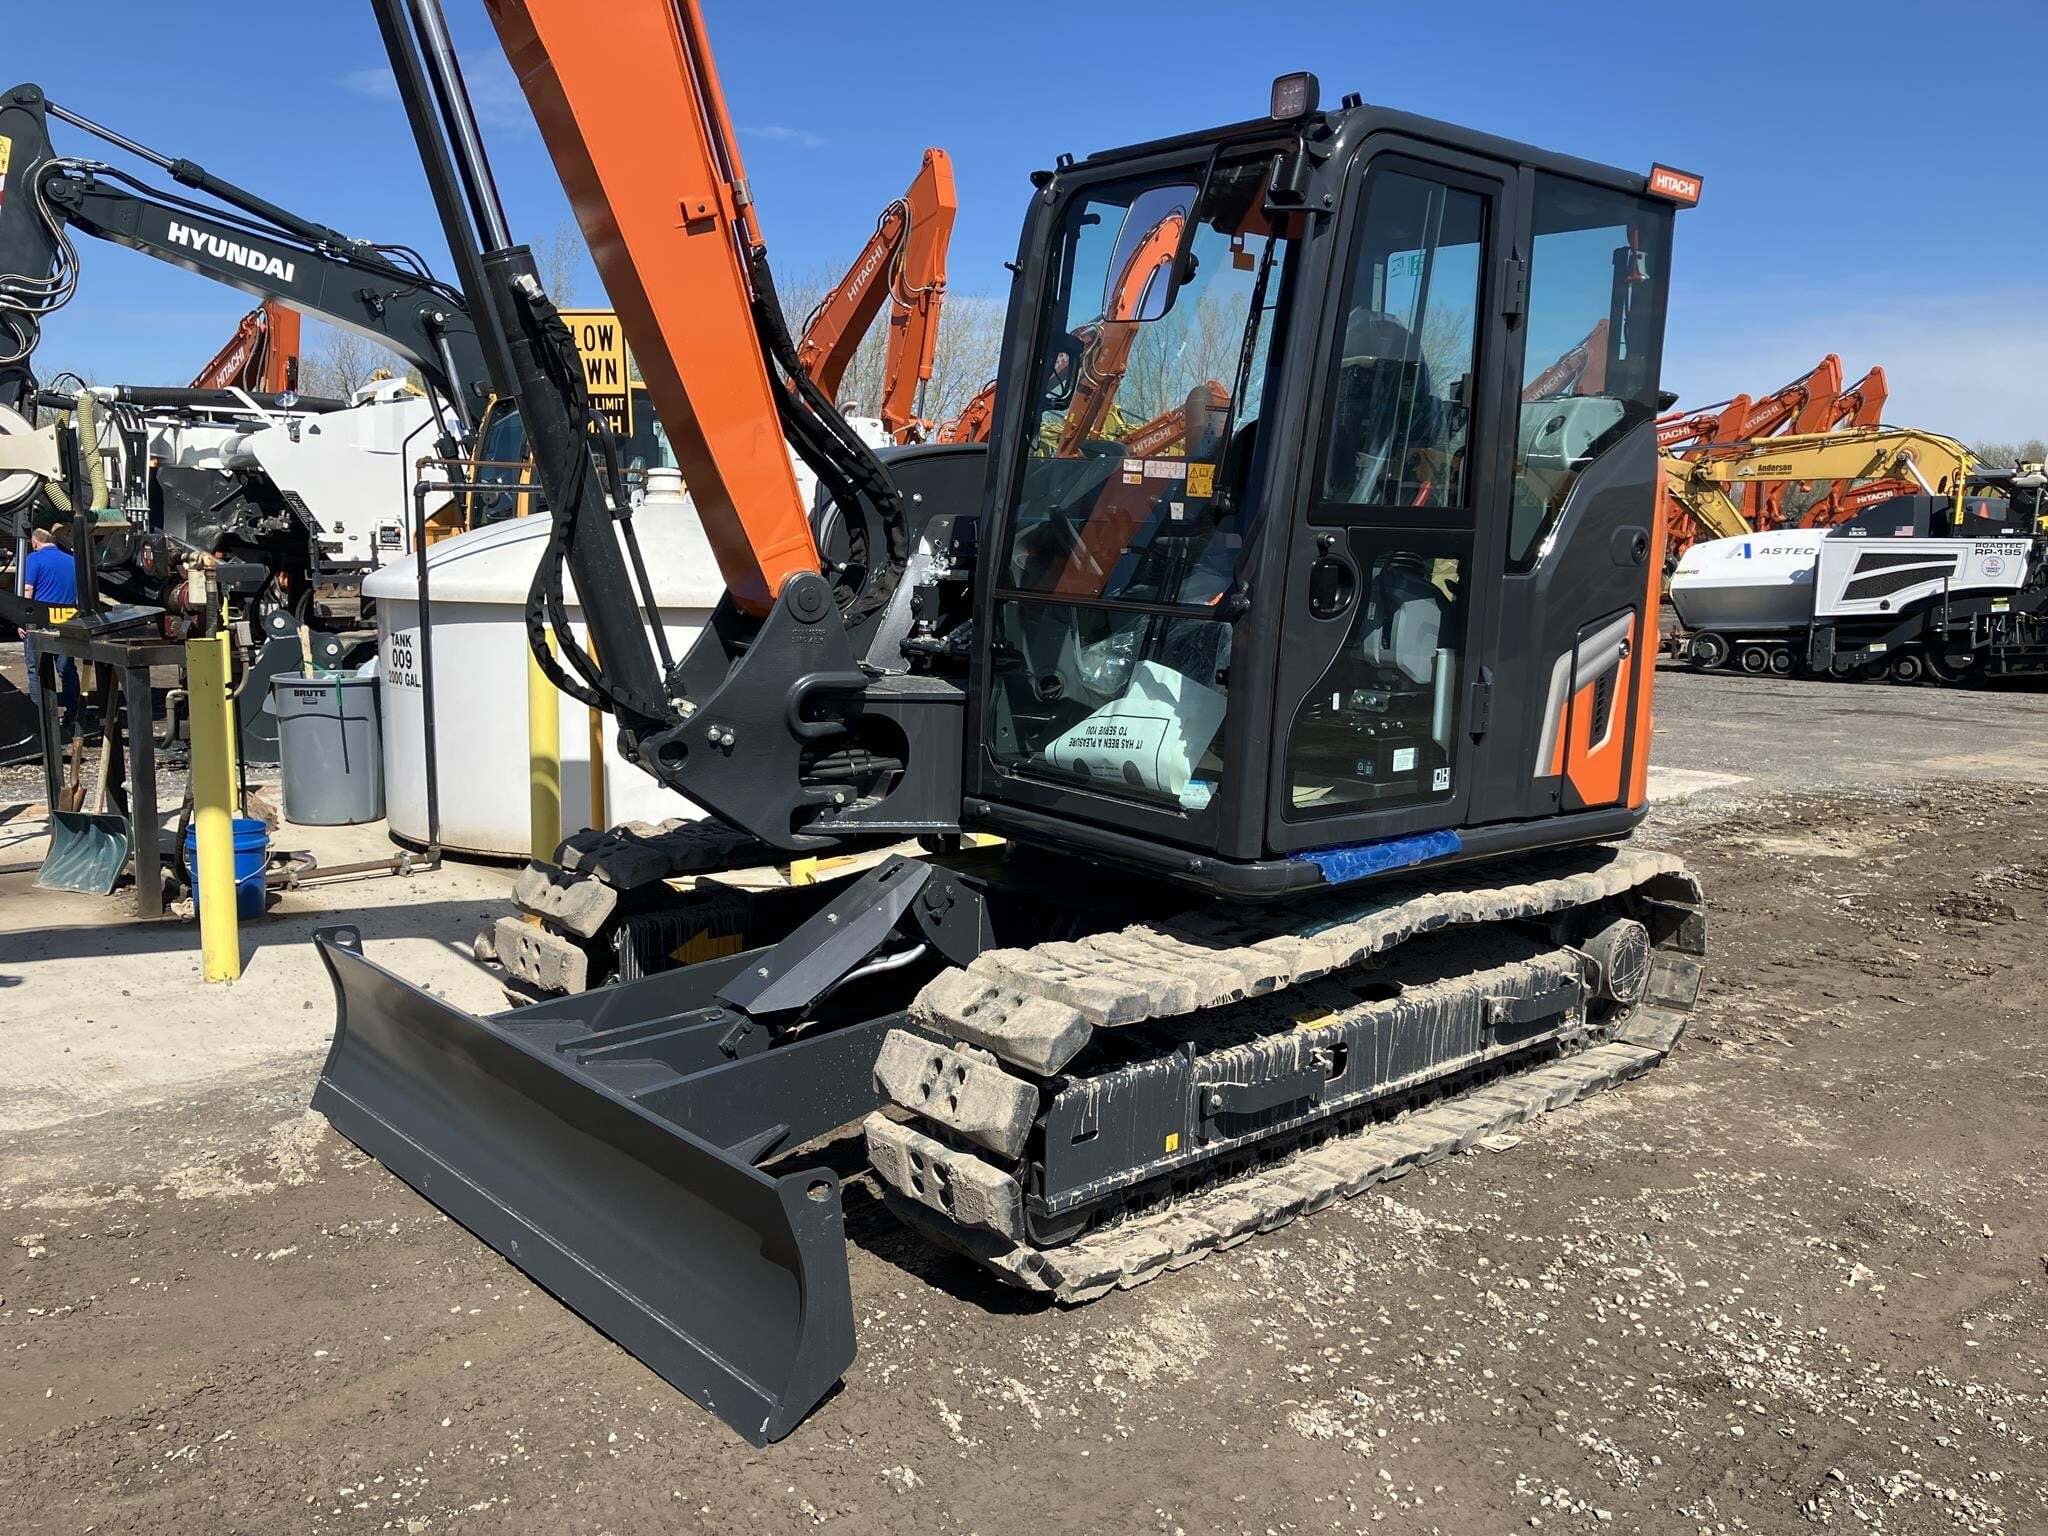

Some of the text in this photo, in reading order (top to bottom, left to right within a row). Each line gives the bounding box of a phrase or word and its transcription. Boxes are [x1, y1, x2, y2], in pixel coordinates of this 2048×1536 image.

[1656, 173, 1696, 197] HITACHI
[167, 221, 295, 282] HYUNDAI
[847, 245, 883, 302] HITACHI
[216, 346, 245, 388] HITACHI
[595, 398, 624, 410] LIMIT
[1132, 428, 1170, 453] HITACHI
[1758, 464, 1792, 472] Anderson
[1857, 490, 1894, 503] HITACHI
[1760, 547, 1815, 555] ASTEC
[1975, 548, 2021, 556] RP-195
[391, 633, 412, 648] TANK
[392, 650, 412, 669] 009
[1086, 726, 1128, 735] TO SERVE YOU
[1069, 737, 1096, 747] PLEASURE
[1104, 738, 1120, 748] BEEN
[1121, 739, 1134, 749] HAS
[1135, 739, 1144, 749] IT
